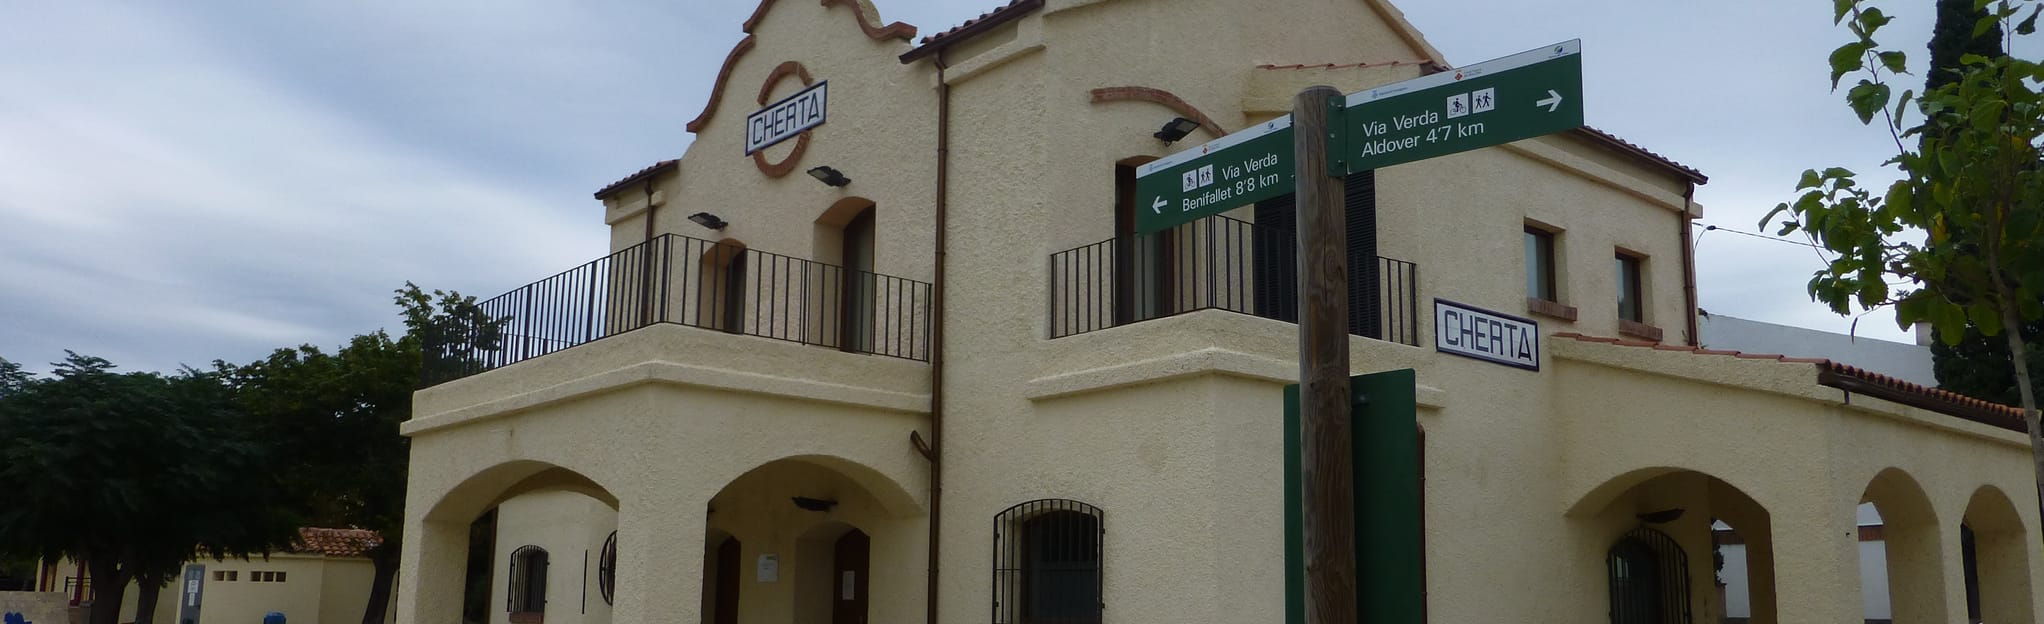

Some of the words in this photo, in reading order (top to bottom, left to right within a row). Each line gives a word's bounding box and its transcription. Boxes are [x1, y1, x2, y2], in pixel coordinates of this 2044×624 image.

[753, 92, 819, 145] CHERTA
[1362, 121, 1387, 137] Via
[1393, 110, 1438, 131] Verda
[1361, 136, 1420, 157] Aldover
[1458, 122, 1484, 138] km
[1222, 165, 1240, 180] Via
[1244, 153, 1278, 173] Verda
[1183, 186, 1232, 212] Benifallet
[1260, 173, 1278, 188] km
[1445, 310, 1532, 361] CHERTA
